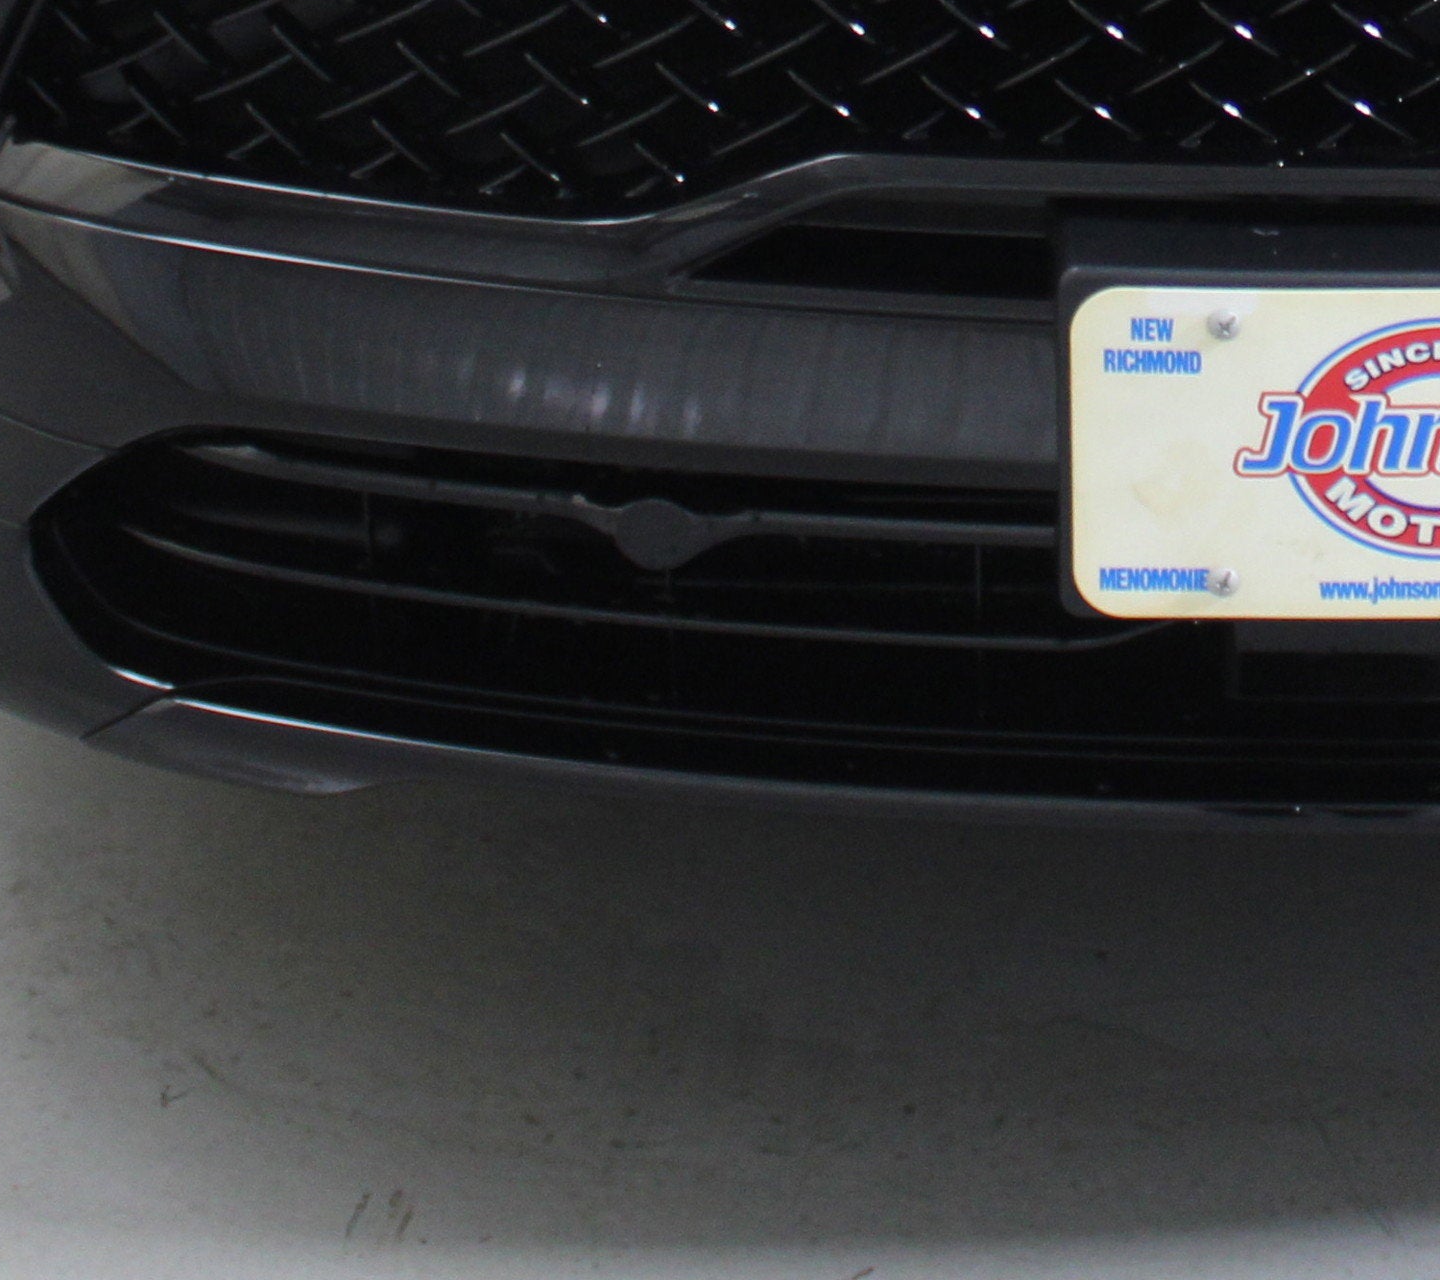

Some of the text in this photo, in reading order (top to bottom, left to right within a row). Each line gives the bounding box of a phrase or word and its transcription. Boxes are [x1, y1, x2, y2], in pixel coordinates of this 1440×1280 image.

[1130, 318, 1174, 342] NEW
[1103, 349, 1202, 374] RICHMOND
[1099, 568, 1210, 592] MENOMONIE
